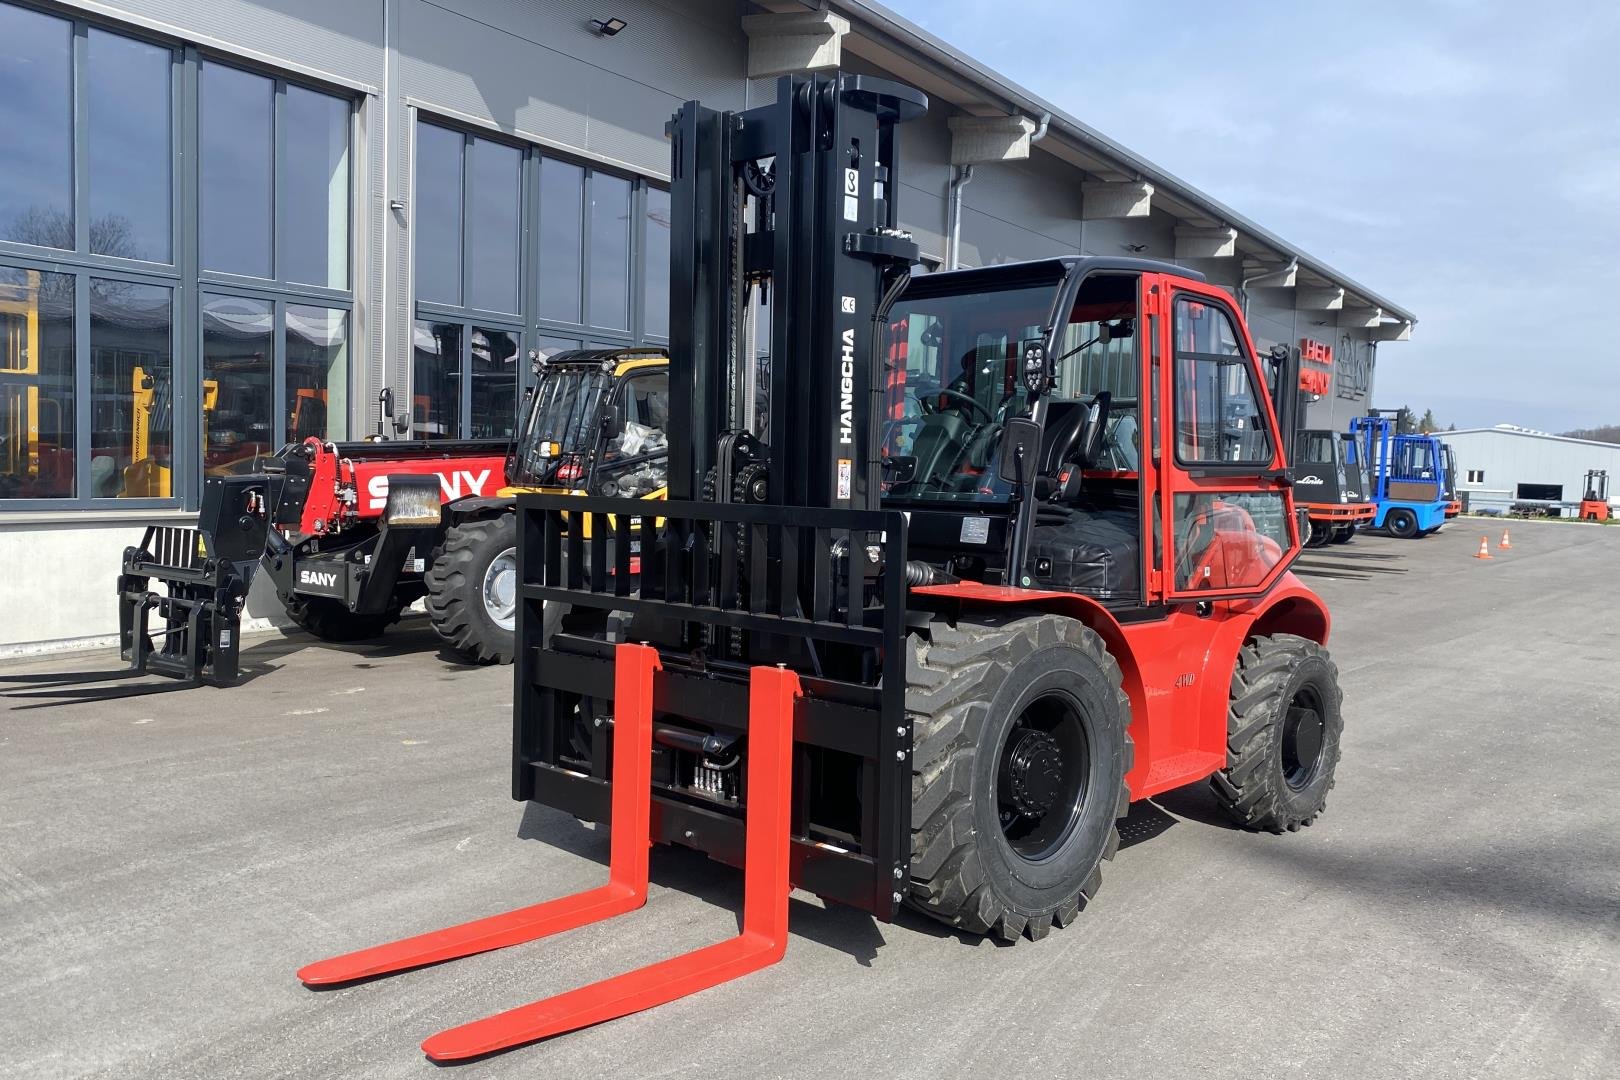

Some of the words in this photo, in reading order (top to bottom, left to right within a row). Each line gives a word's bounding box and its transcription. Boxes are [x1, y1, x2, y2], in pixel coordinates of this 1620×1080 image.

[1302, 338, 1333, 366] HELI
[840, 328, 855, 444] HANGCHA
[368, 469, 491, 509] SNY
[300, 570, 336, 587] SANY
